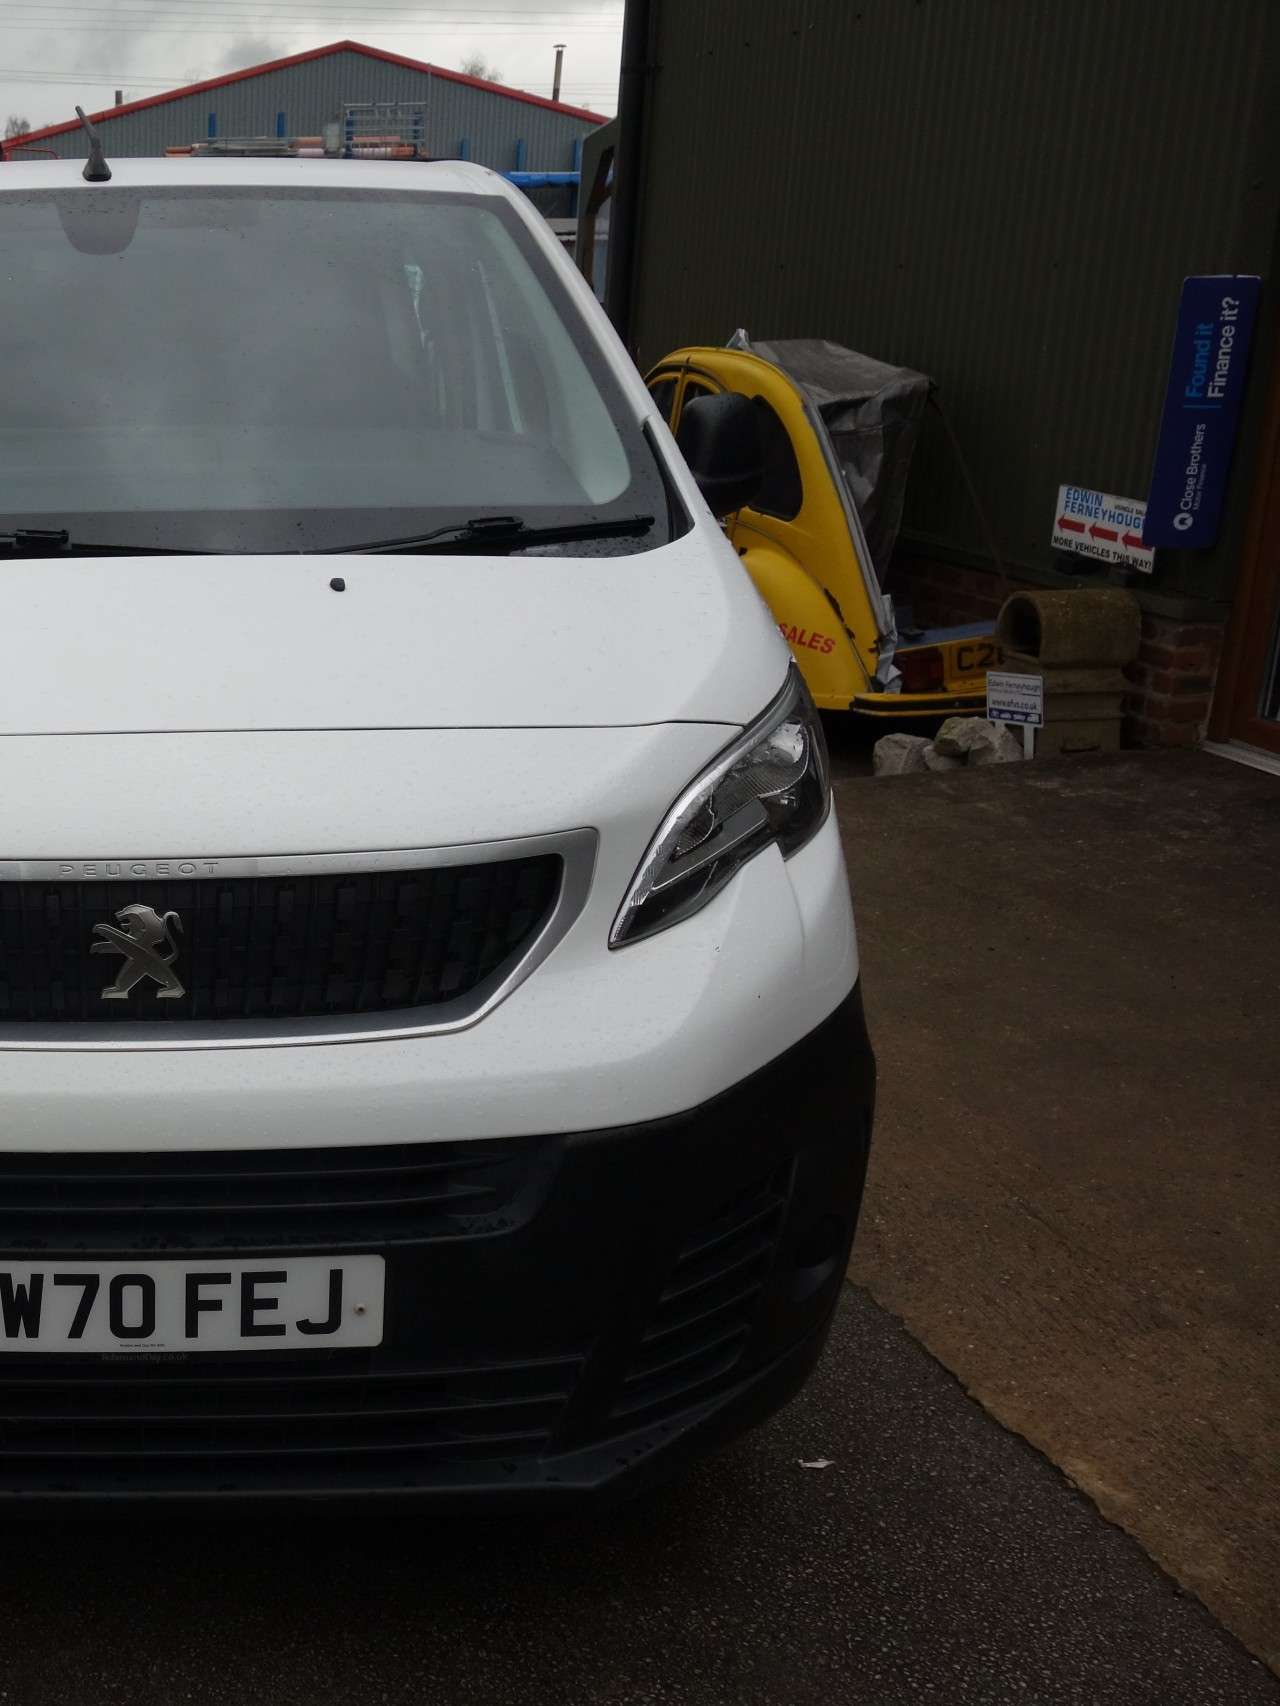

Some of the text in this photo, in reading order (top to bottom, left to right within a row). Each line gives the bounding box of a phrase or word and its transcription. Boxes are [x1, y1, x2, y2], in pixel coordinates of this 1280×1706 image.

[1184, 320, 1215, 399] Found it
[1207, 296, 1240, 398] Finance it?
[1180, 423, 1207, 511] Close Brothers
[1064, 500, 1144, 529] FERNEYHOUG
[1065, 487, 1103, 507] EDWIN
[1053, 535, 1073, 548] MORE
[1074, 541, 1111, 559] VEHICLES
[1112, 551, 1131, 563] THIS
[58, 862, 219, 877] PEUGEOT
[184, 1268, 344, 1339] FEJ
